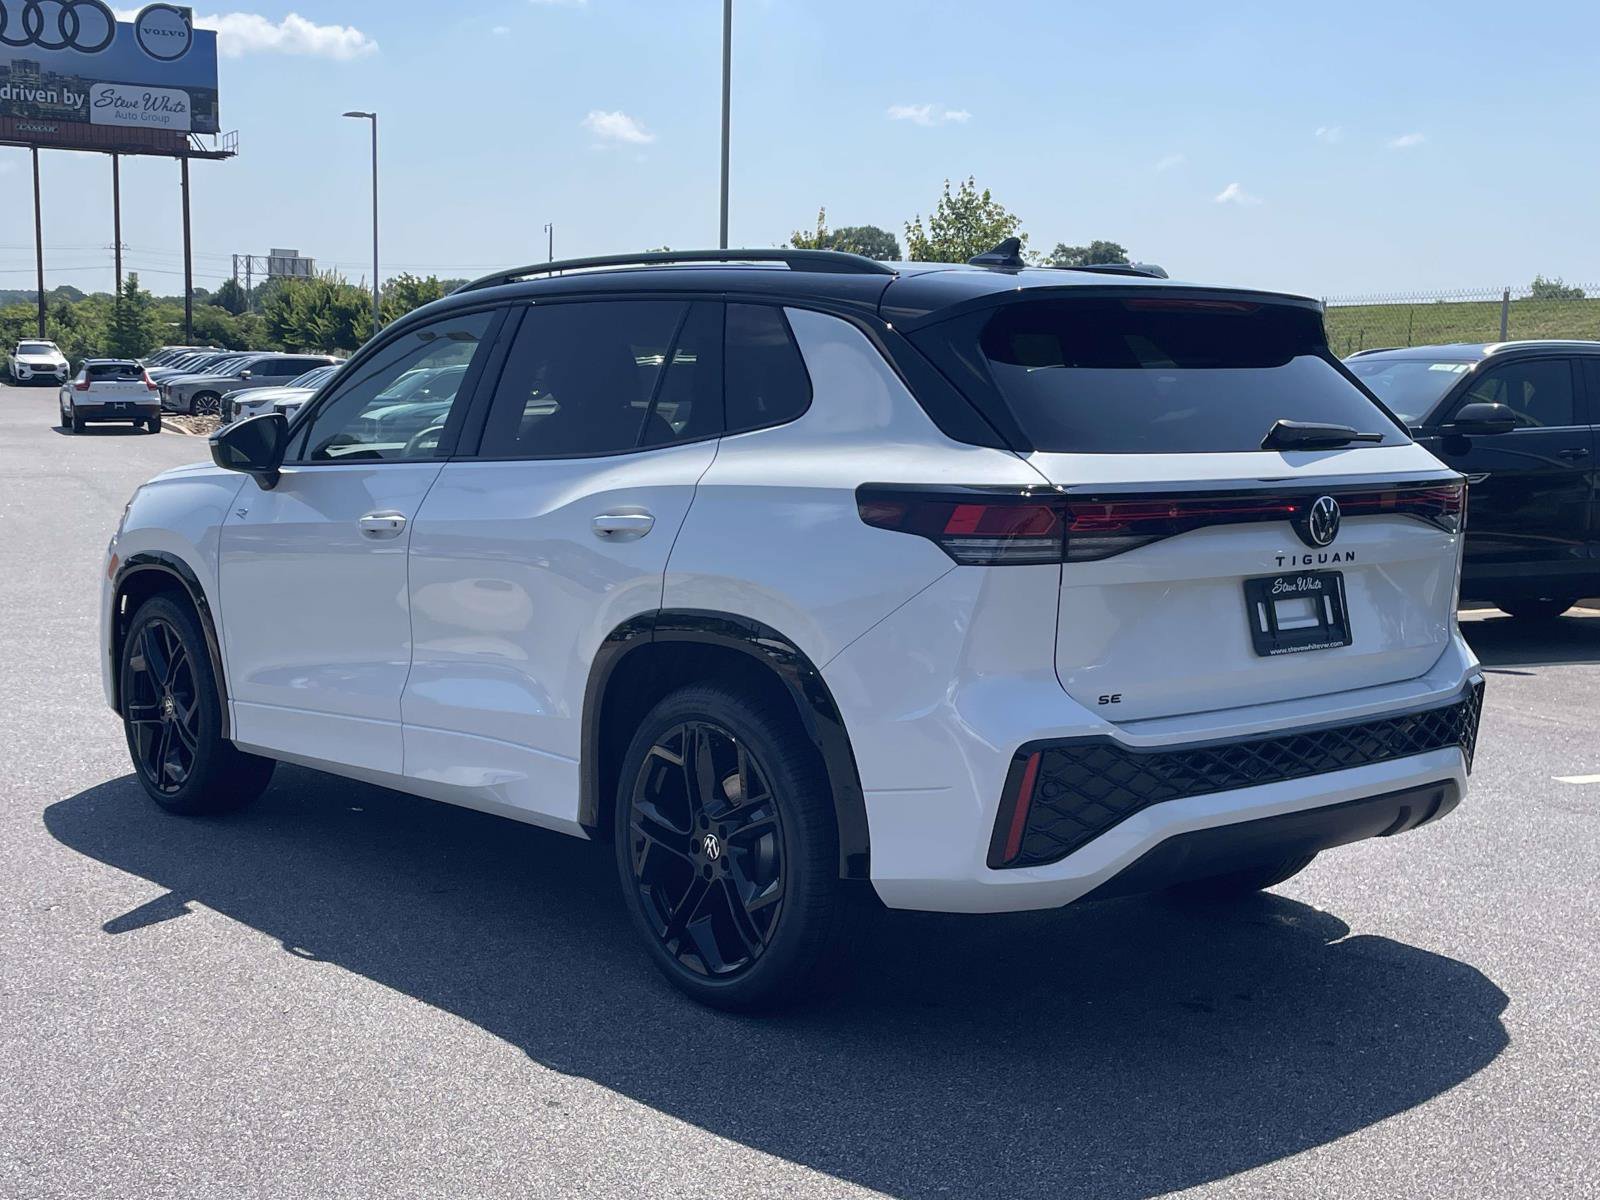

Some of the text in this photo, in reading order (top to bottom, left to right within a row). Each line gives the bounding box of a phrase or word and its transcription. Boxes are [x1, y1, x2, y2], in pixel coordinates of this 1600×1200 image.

[143, 28, 186, 37] VOLVO
[0, 83, 85, 110] driven by
[94, 89, 187, 113] Steve White
[115, 111, 170, 123] Auto Group
[1275, 551, 1355, 567] TIGUAN
[1272, 577, 1322, 593] Steve White
[1270, 641, 1344, 655] www.stevewhitevw.com
[1098, 694, 1122, 705] SE
